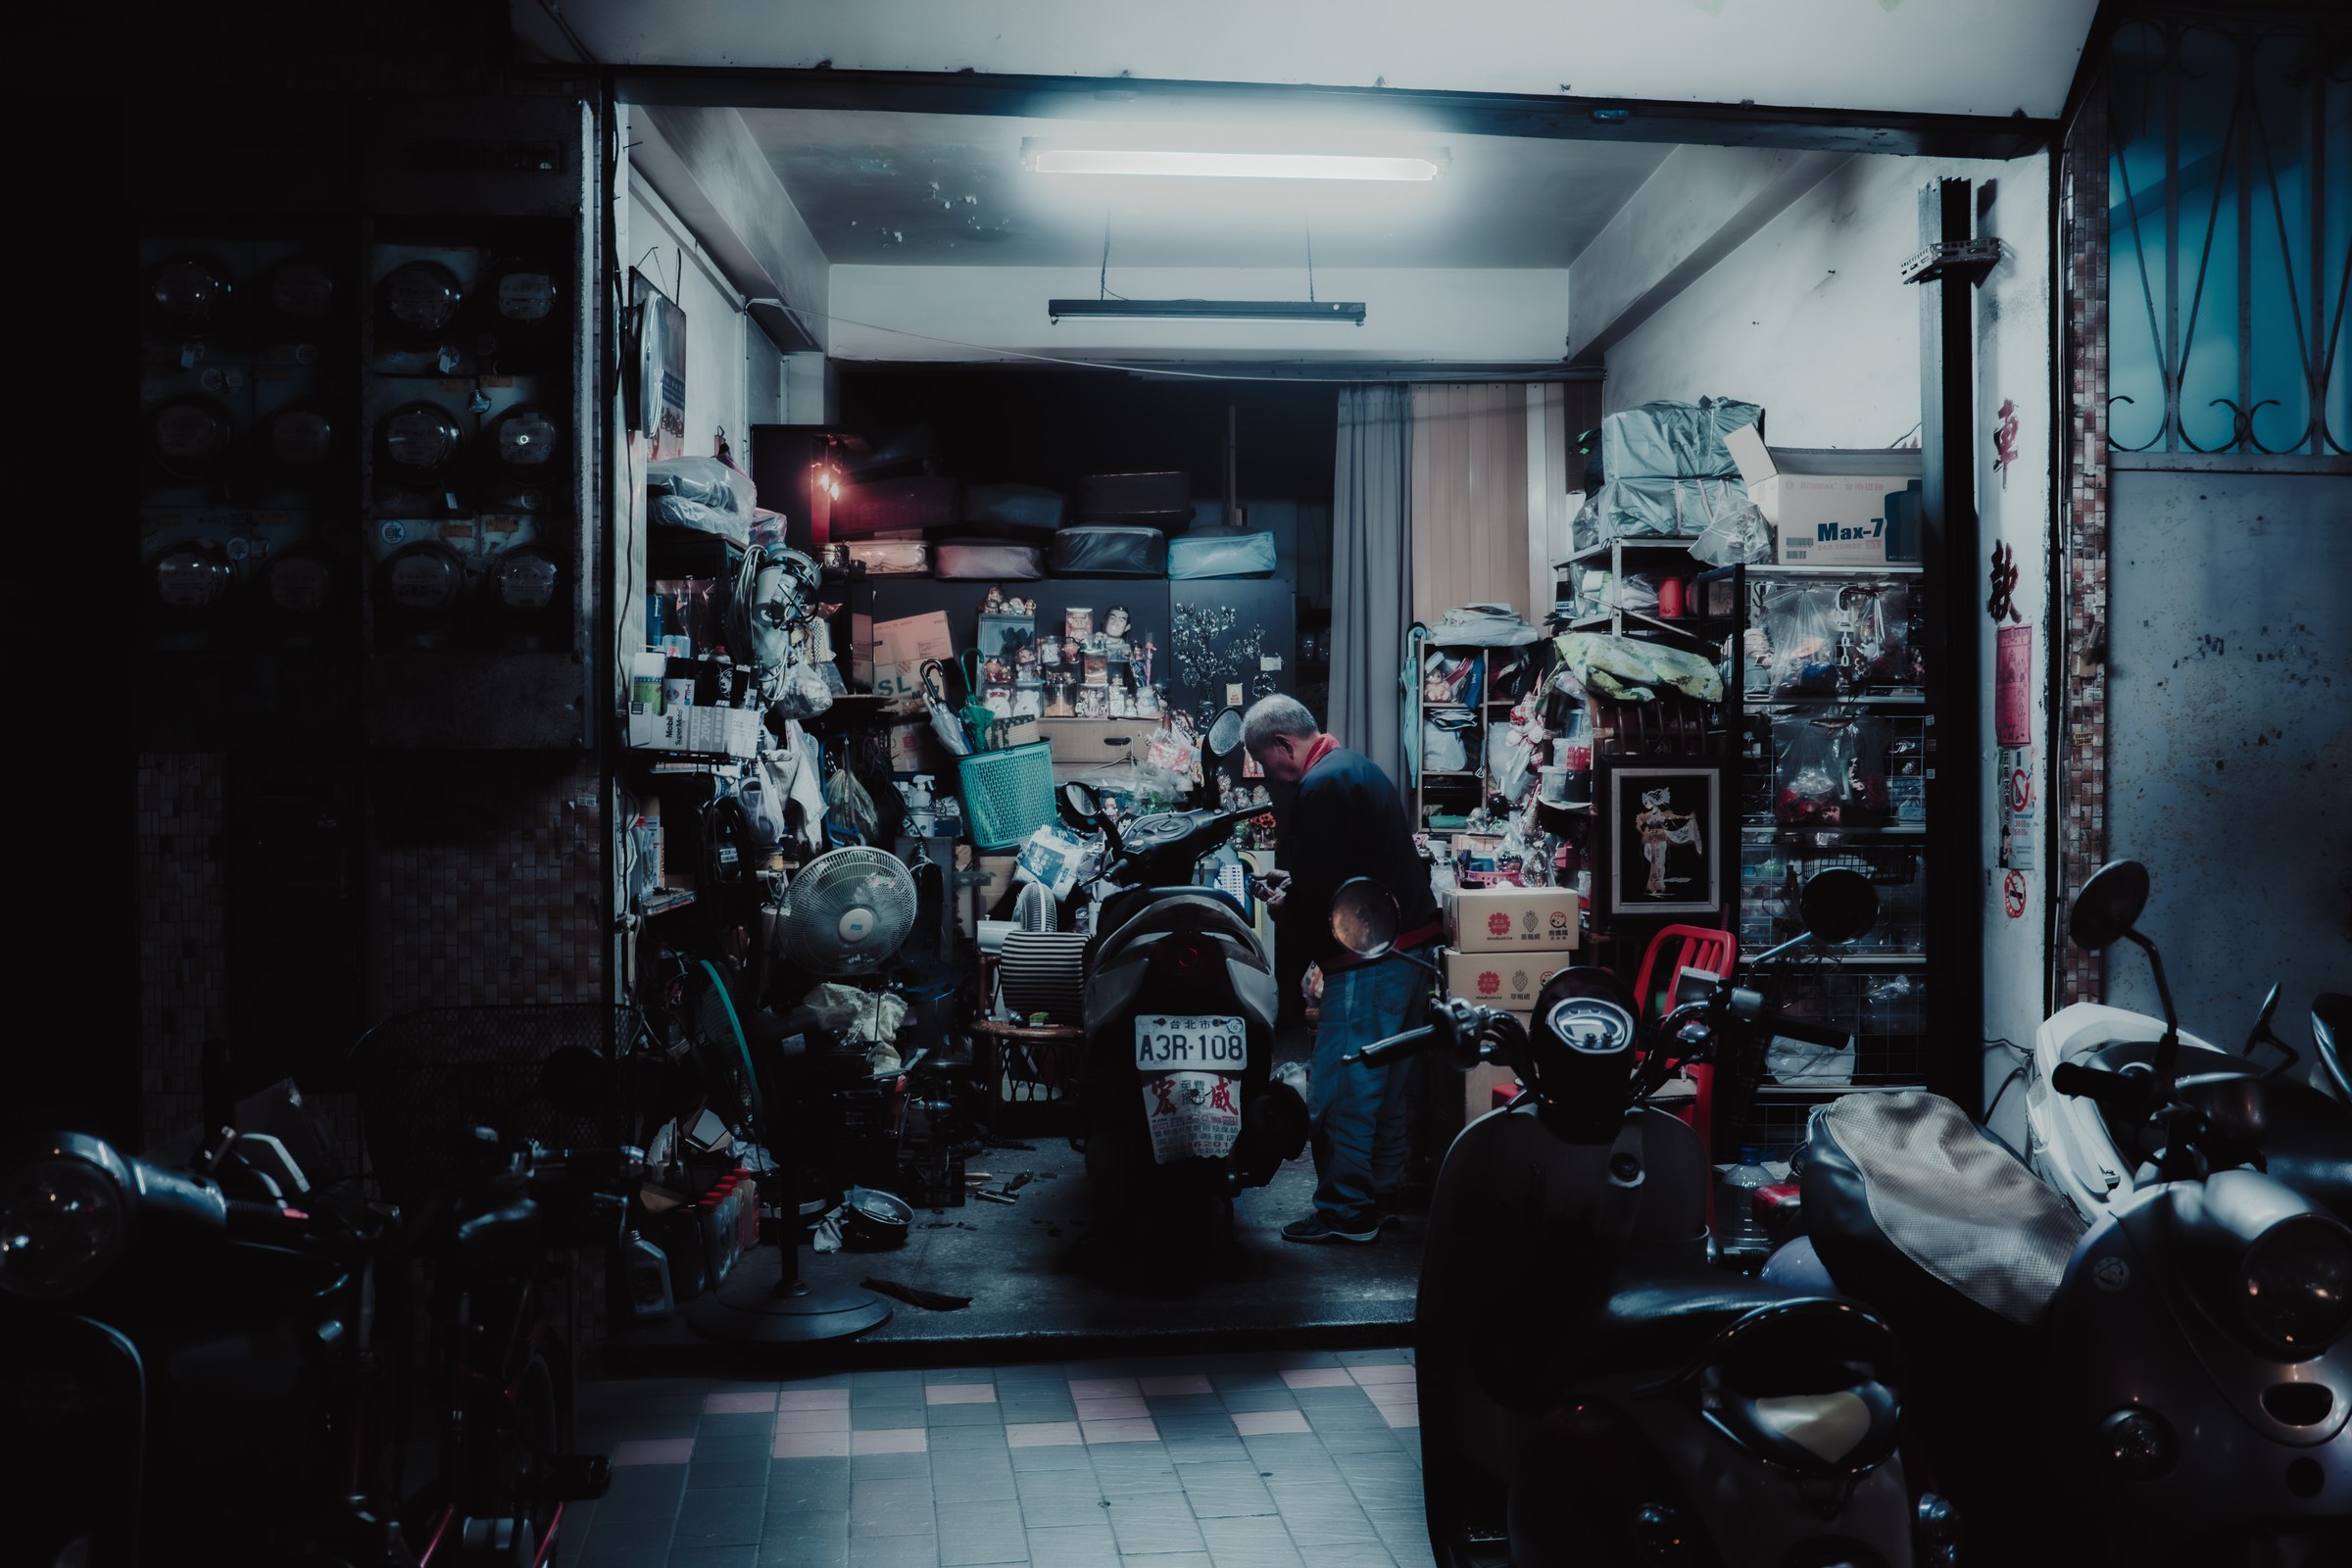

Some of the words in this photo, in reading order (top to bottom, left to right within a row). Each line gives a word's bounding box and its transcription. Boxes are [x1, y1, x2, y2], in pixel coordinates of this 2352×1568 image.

[1818, 517, 1884, 542] Max-7
[1169, 1019, 1212, 1030] 台北市
[1139, 1034, 1243, 1061] A3R-108
